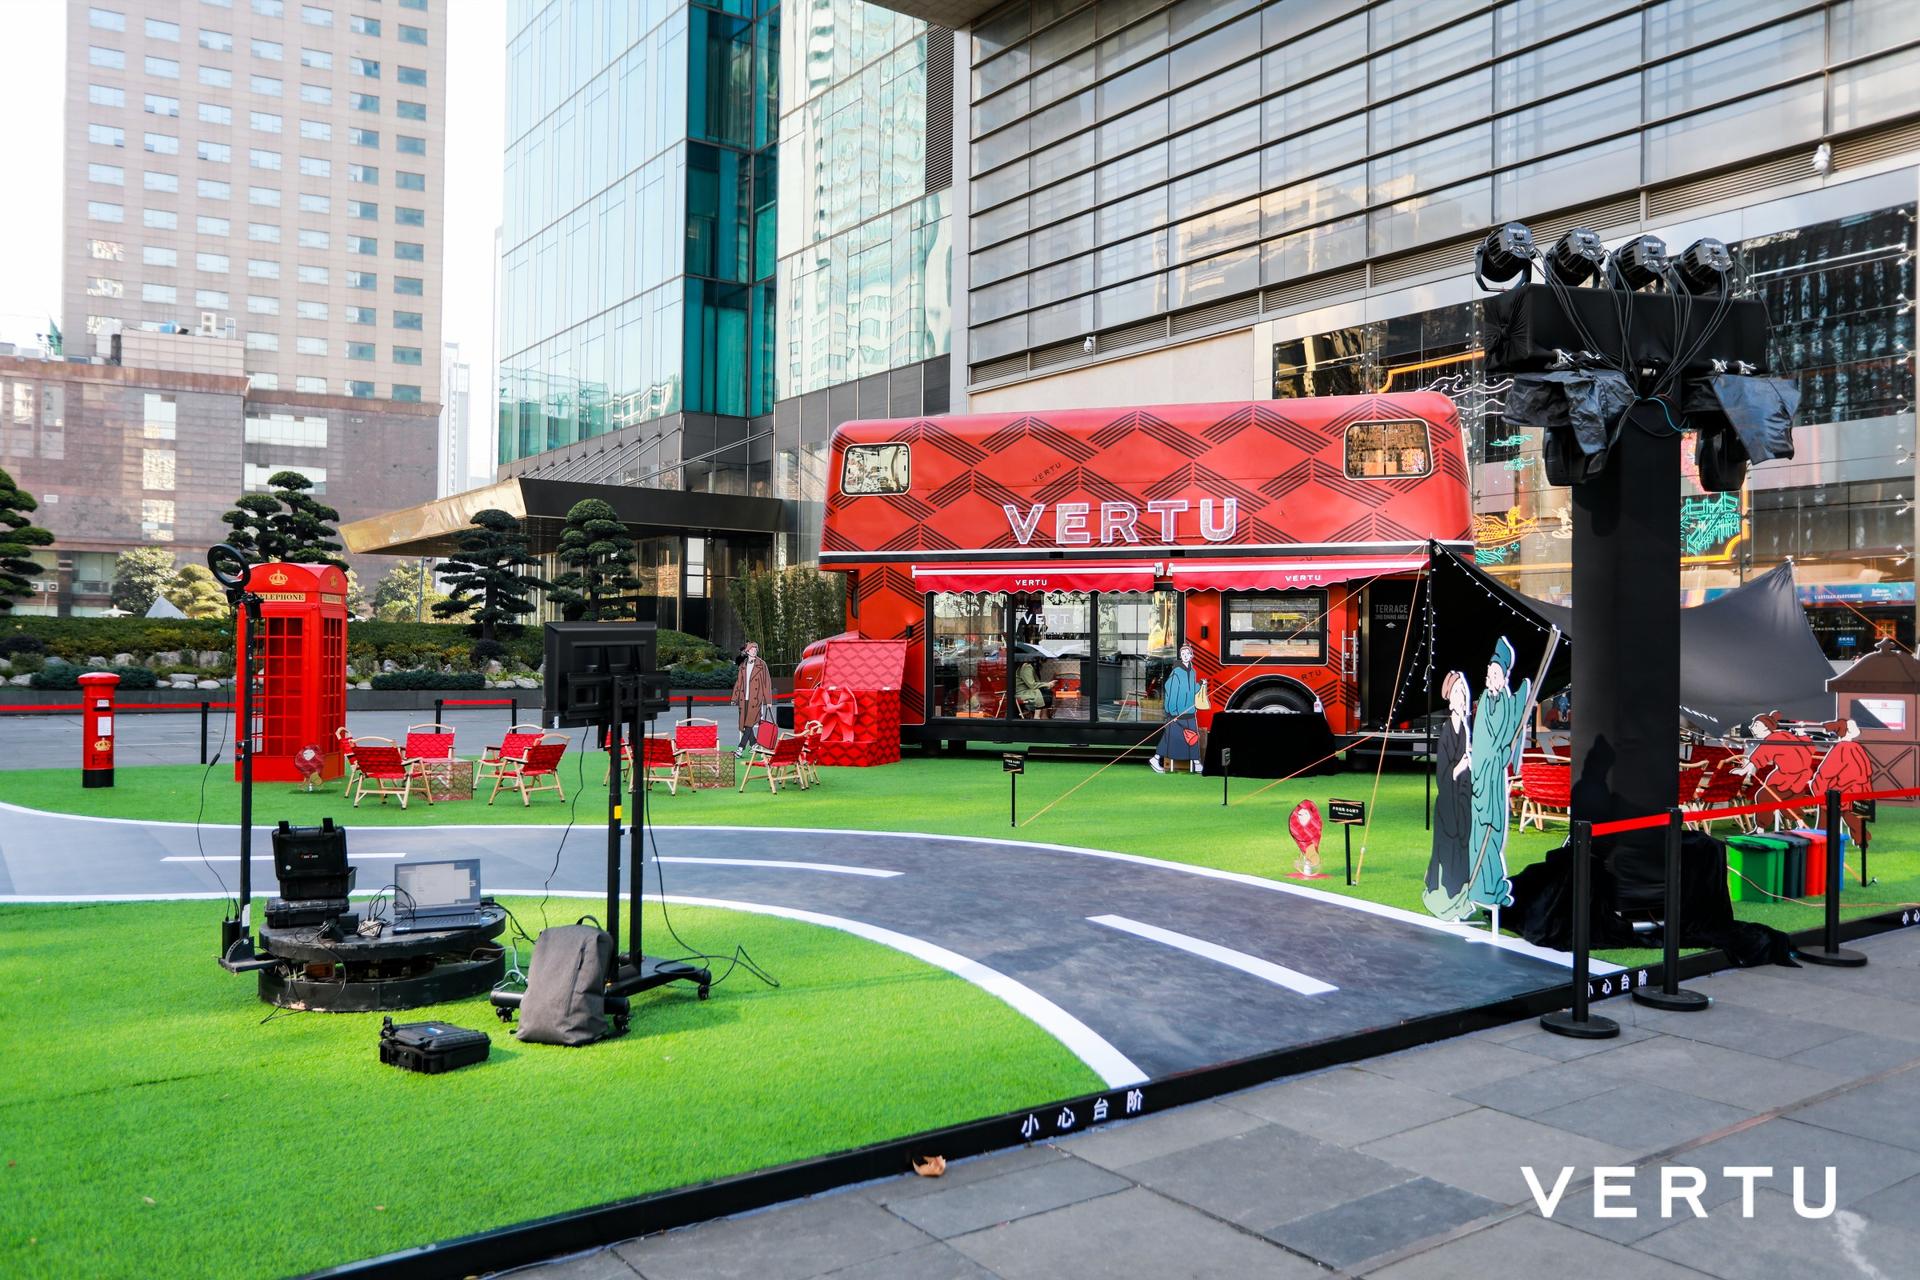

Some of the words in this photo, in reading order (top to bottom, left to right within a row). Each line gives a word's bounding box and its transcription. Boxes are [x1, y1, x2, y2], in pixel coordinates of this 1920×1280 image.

[1032, 462, 1063, 482] VERTU
[1003, 497, 1238, 545] VERTU
[1284, 574, 1321, 582] VERTU
[1375, 604, 1408, 613] TERRACE
[1020, 1088, 1144, 1138] 小心台阶
